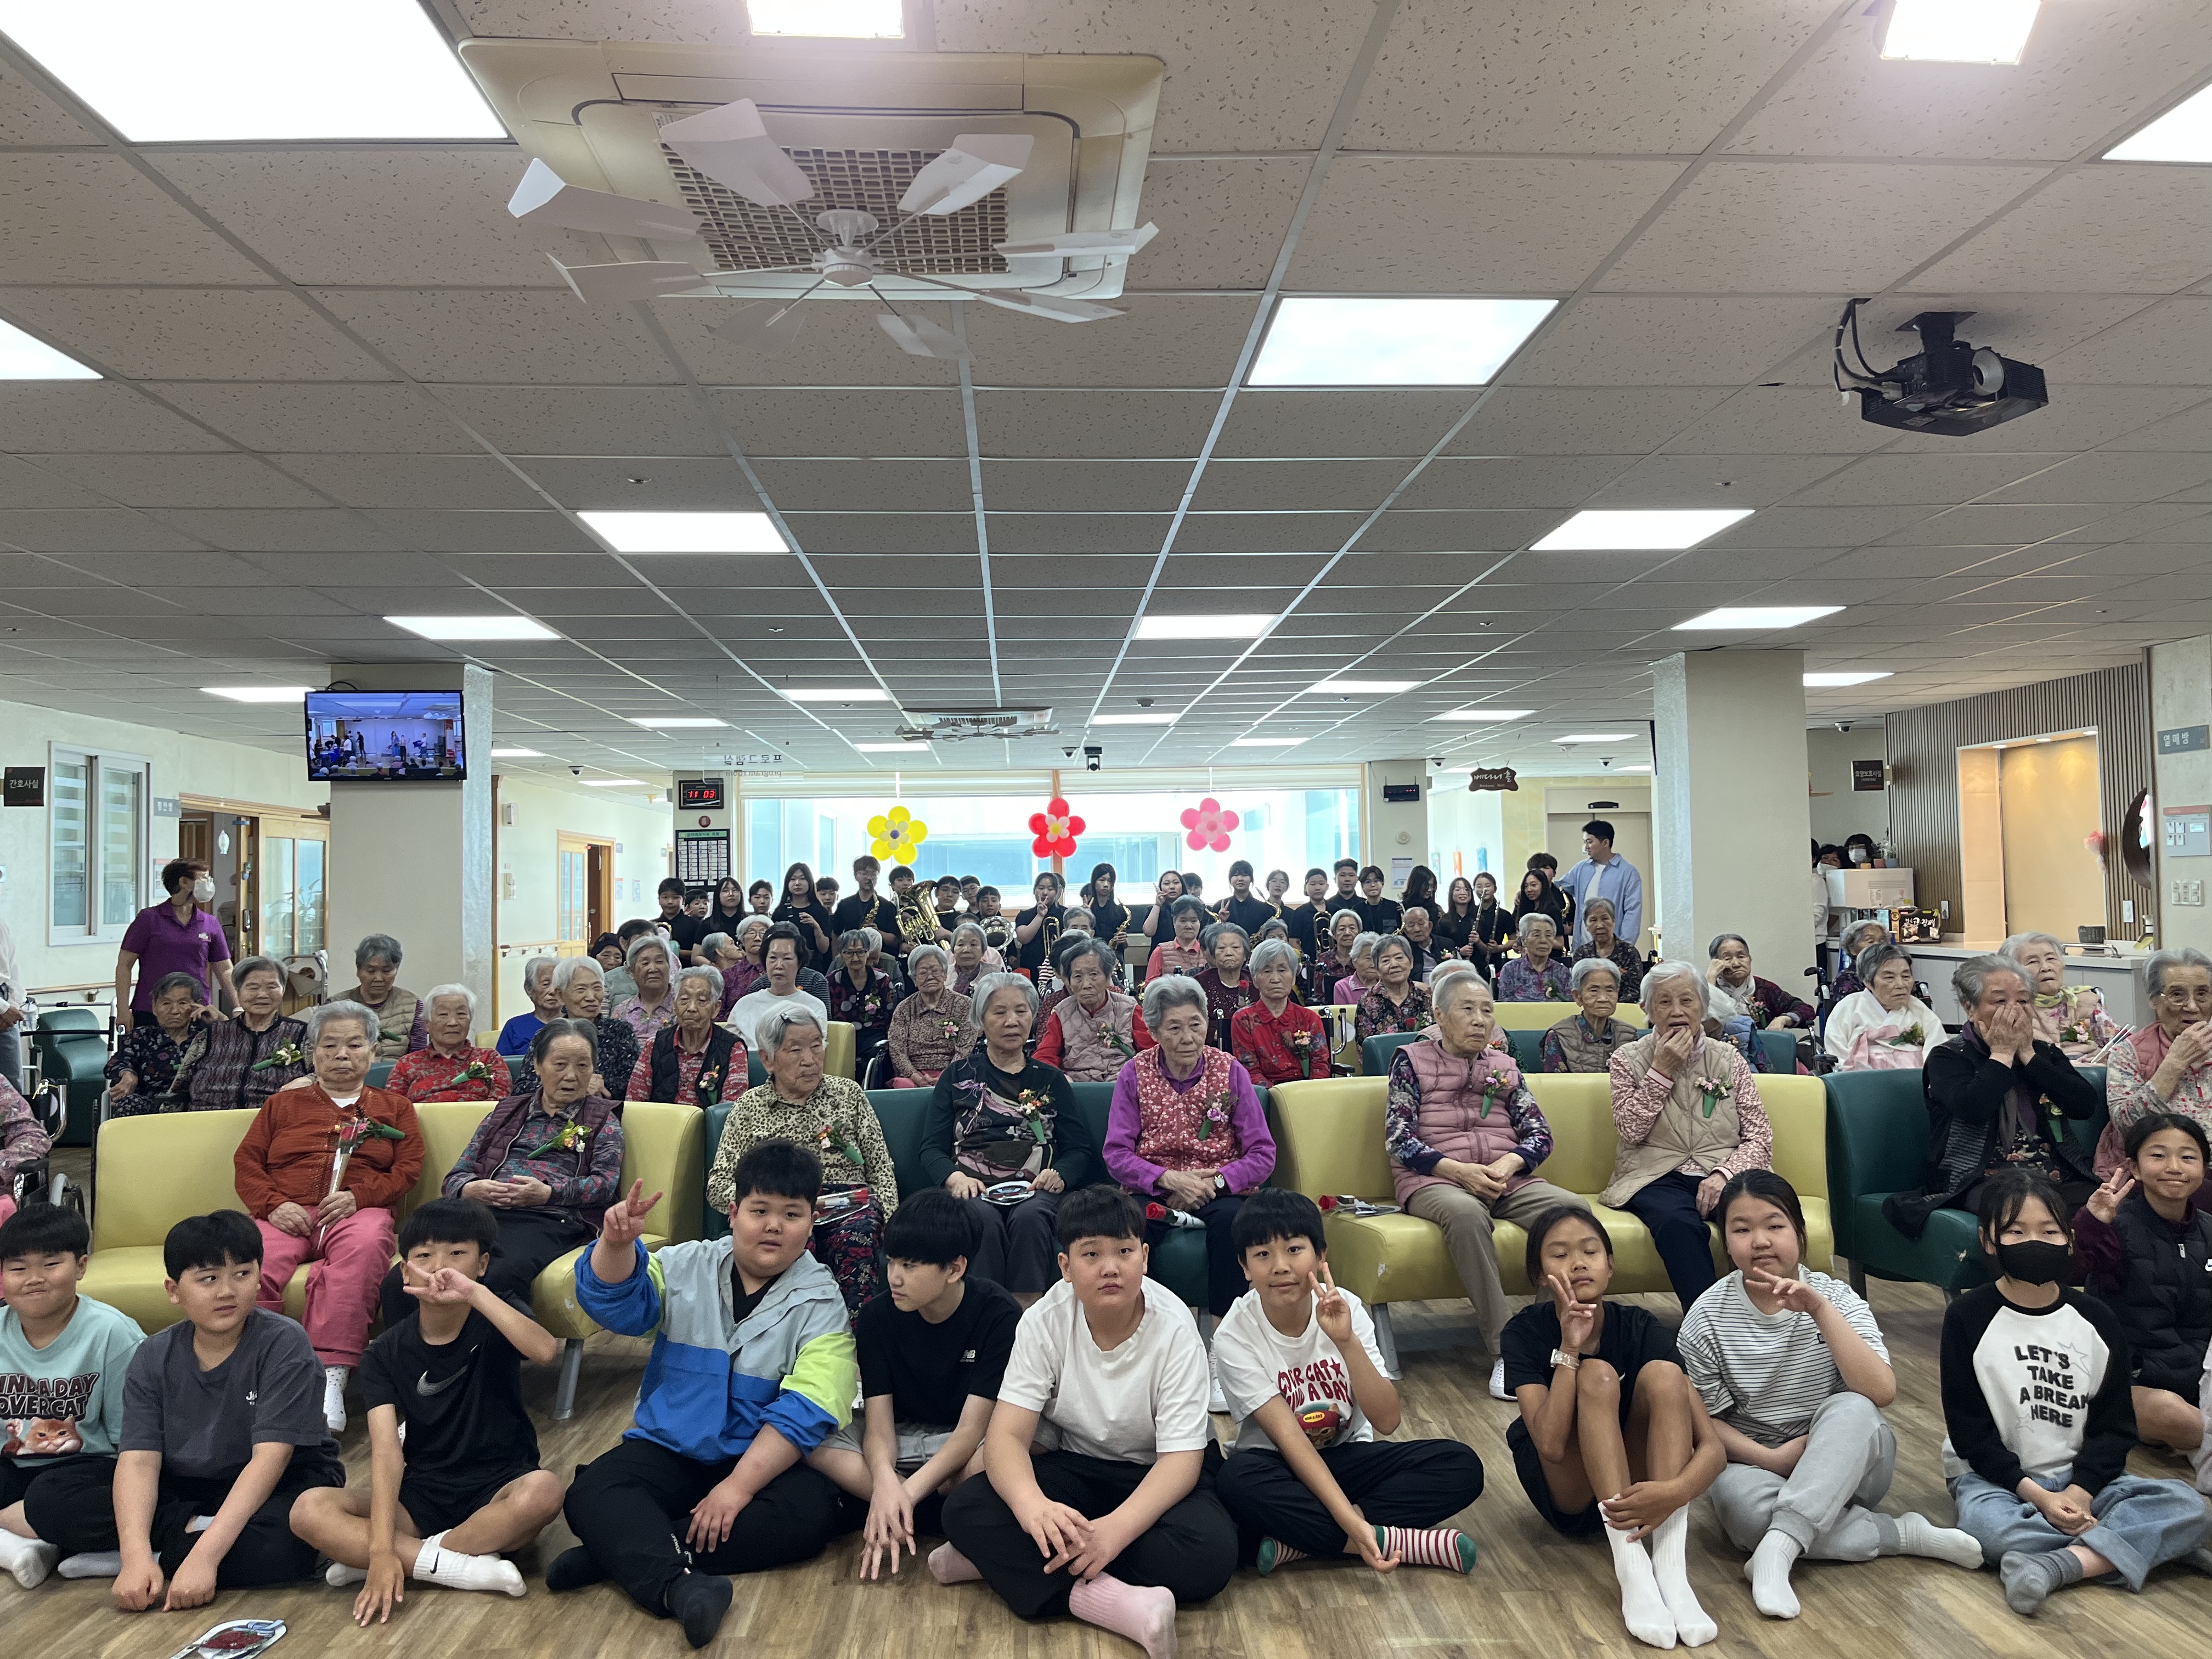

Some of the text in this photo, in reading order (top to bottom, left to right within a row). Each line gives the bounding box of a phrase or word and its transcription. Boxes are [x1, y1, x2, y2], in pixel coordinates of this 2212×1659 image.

[2163, 732, 2189, 747] 열매방
[9, 779, 38, 789] 간호사실
[1503, 770, 1512, 783] 홀
[2014, 1345, 2070, 1369] LET'S
[1306, 1359, 1332, 1382] CAT
[2027, 1365, 2074, 1390] TAKE
[1308, 1383, 1321, 1401] A
[1319, 1380, 1354, 1408] DAY
[2019, 1386, 2031, 1404] A
[2030, 1404, 2073, 1428] HERE
